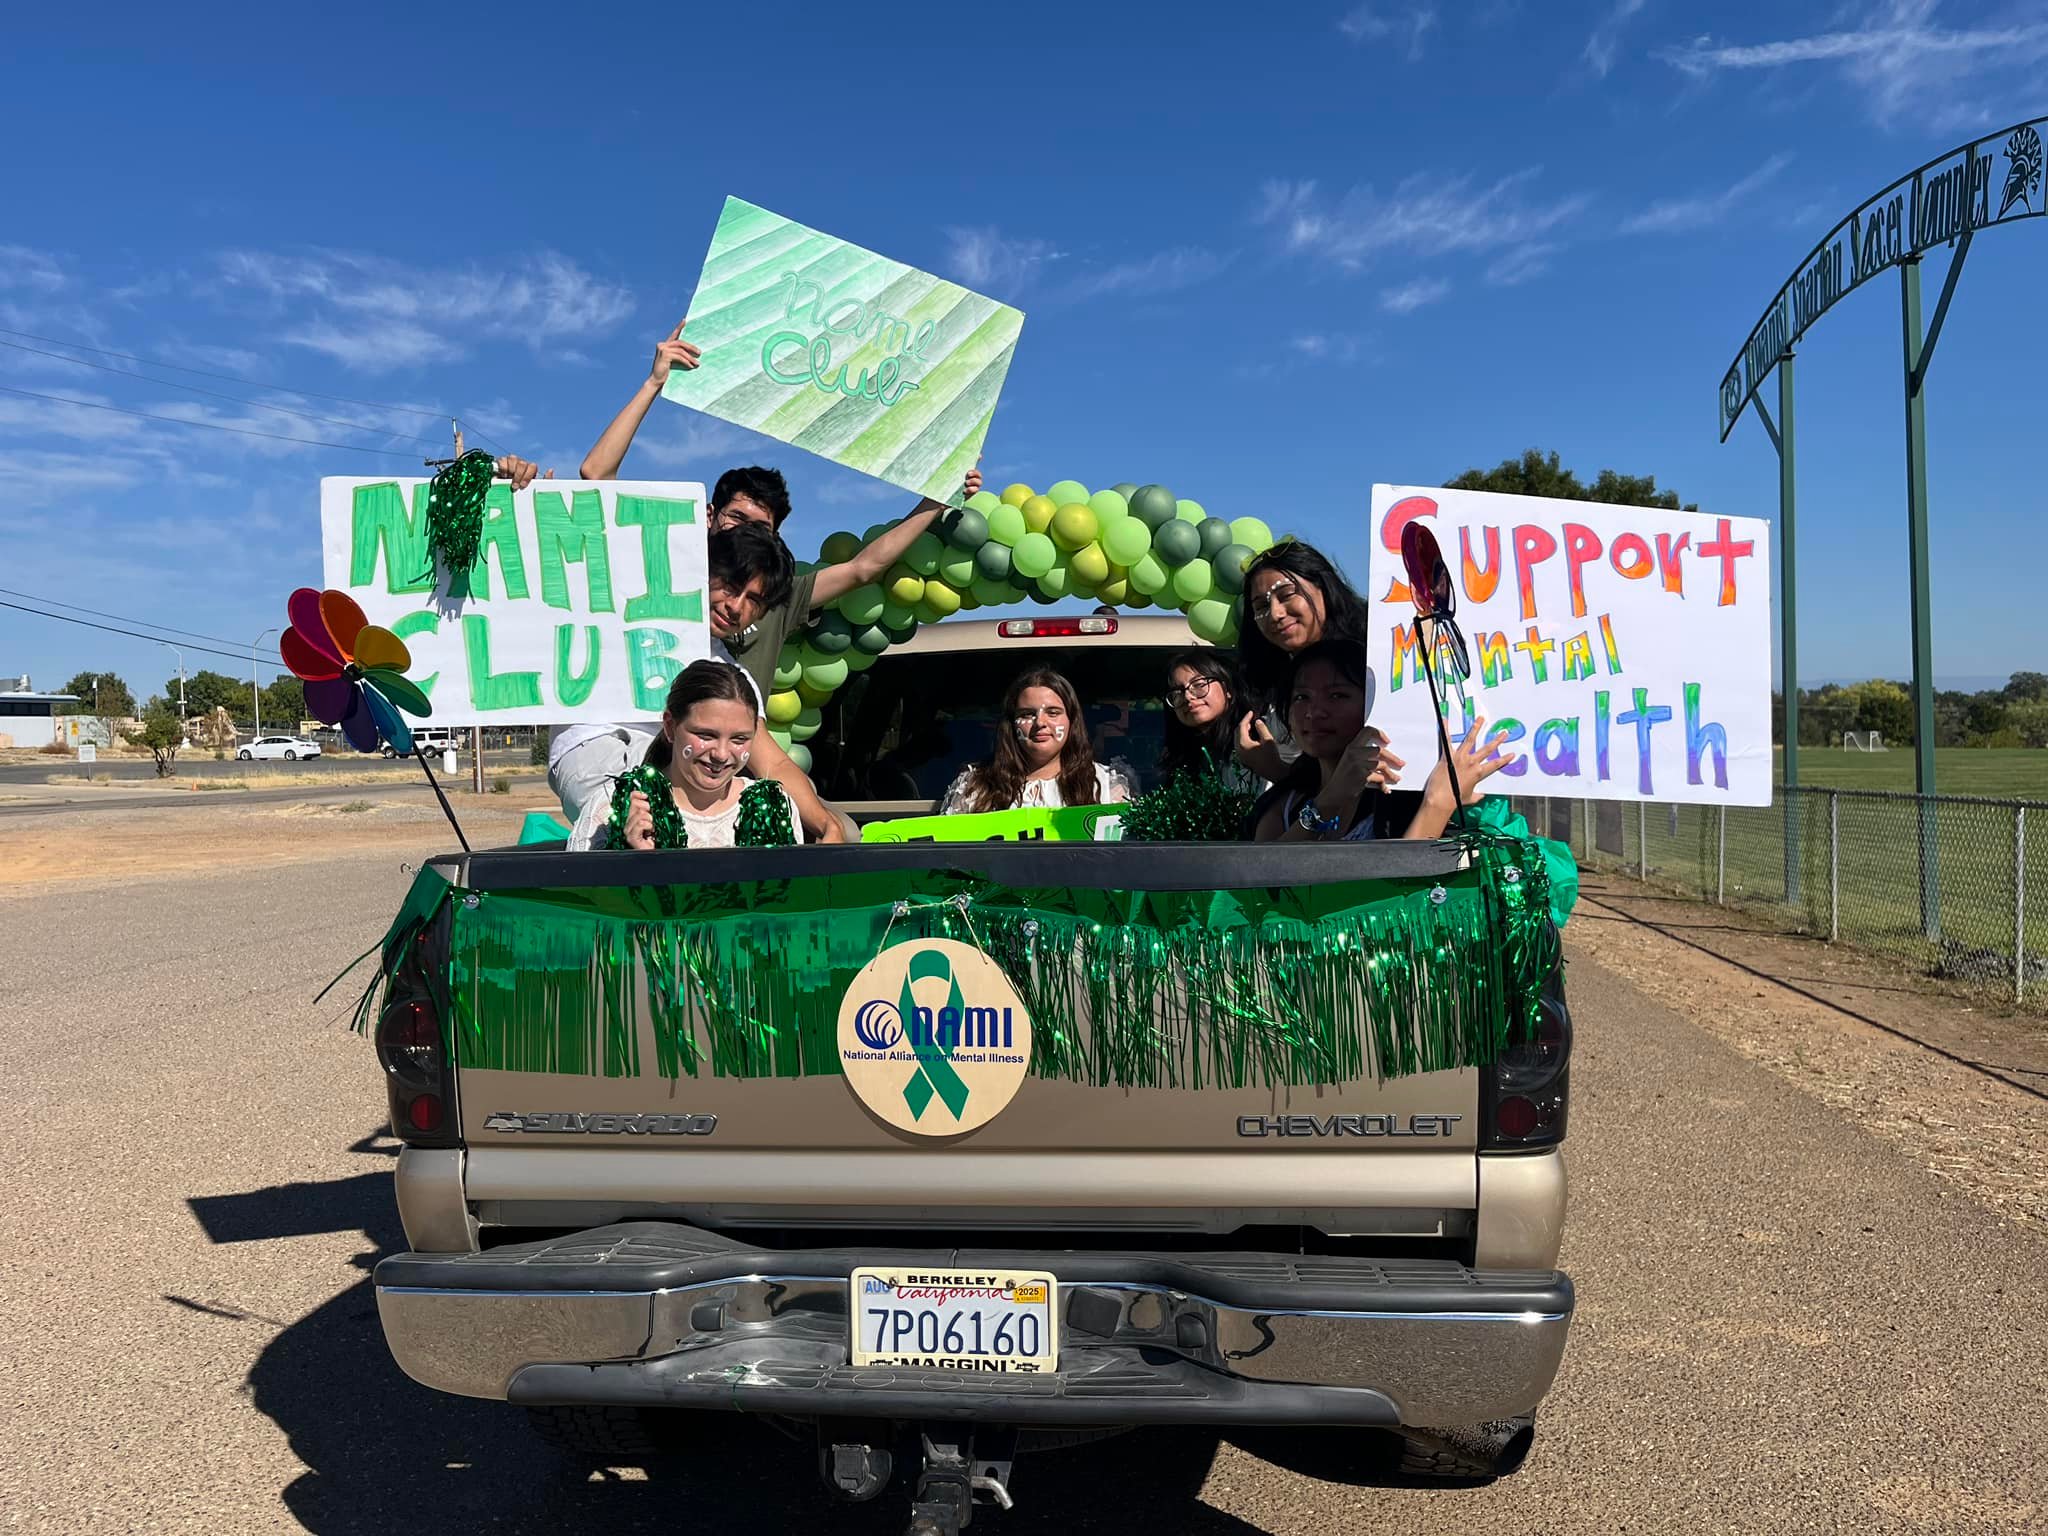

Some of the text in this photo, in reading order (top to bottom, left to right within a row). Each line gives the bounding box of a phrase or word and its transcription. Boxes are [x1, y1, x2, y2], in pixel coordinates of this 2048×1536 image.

[1793, 239, 1842, 342] Spartan
[1850, 193, 1904, 286] Soccer
[1909, 153, 1993, 249] Complex
[761, 330, 920, 407] Club
[350, 481, 703, 623] NAMI
[843, 1050, 1025, 1064] National Alliance on Mental Illness
[523, 1112, 718, 1135] SILVERADO
[1236, 1114, 1462, 1137] CHEVROLET
[907, 1275, 998, 1286] BERKELEY
[1018, 1287, 1040, 1296] 2025
[868, 1308, 1039, 1357] 7P06160
